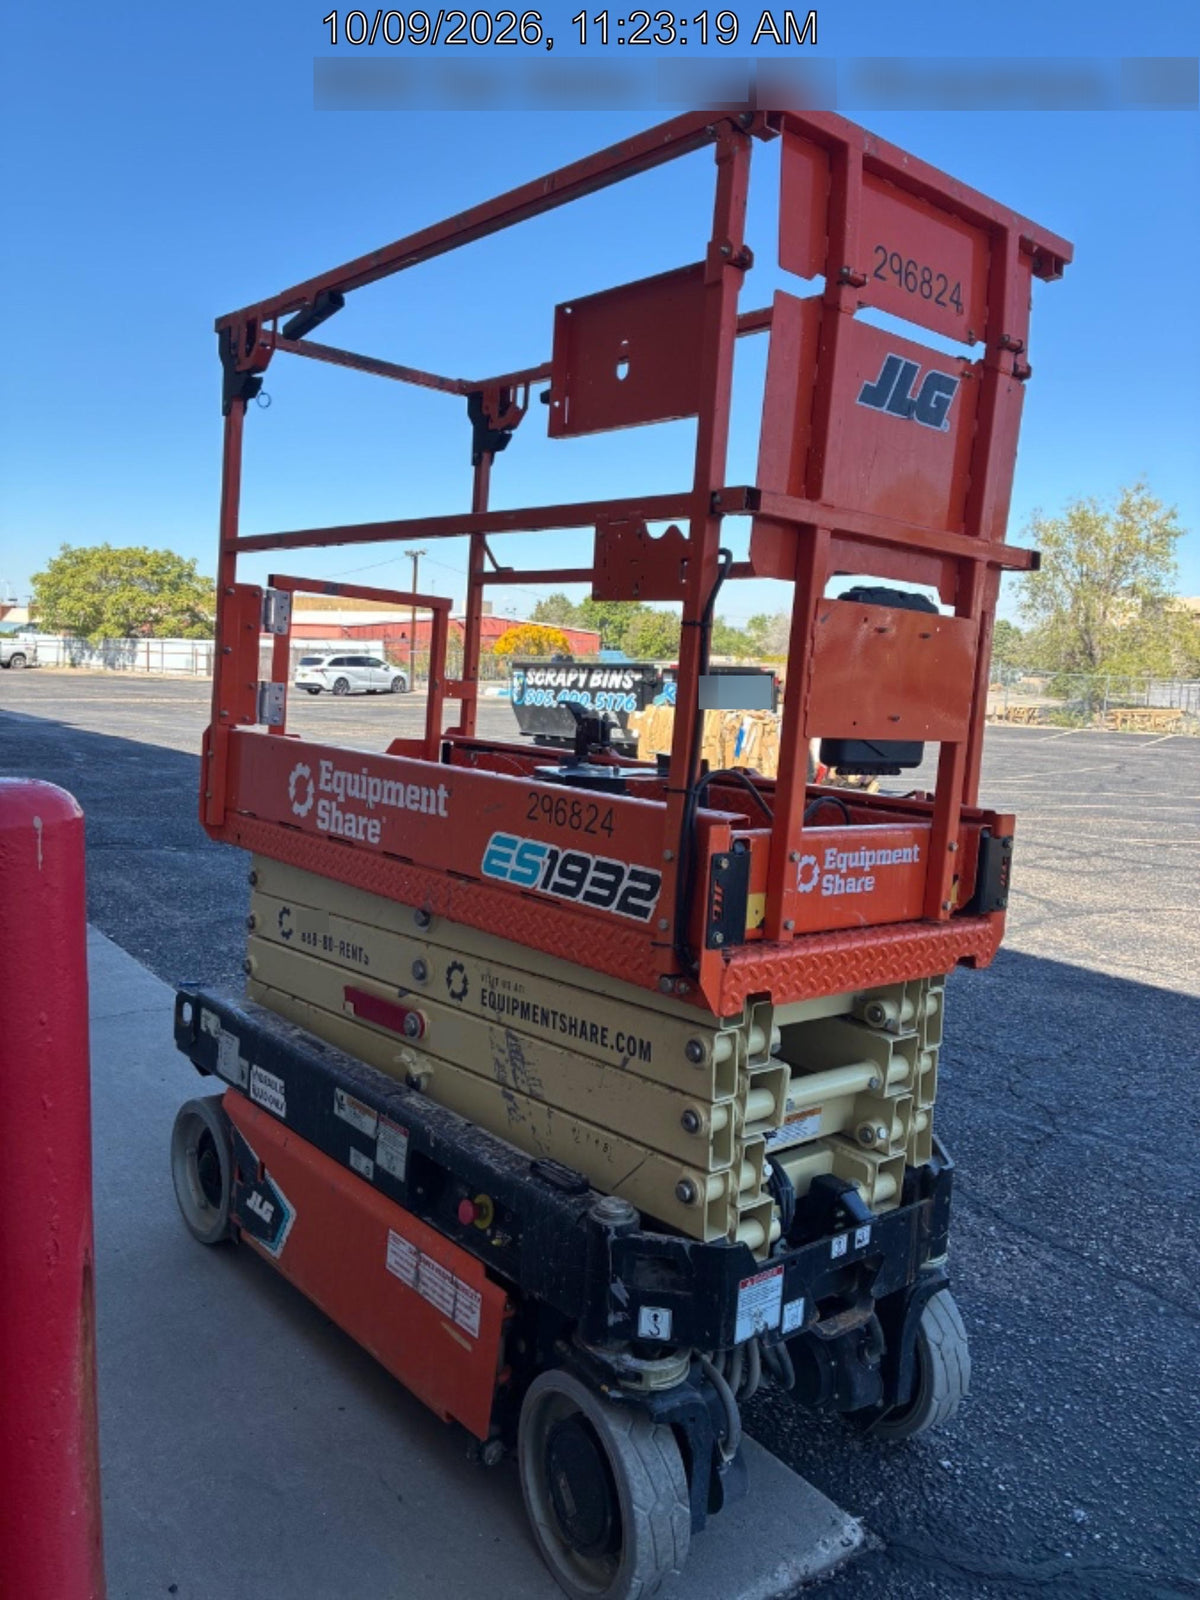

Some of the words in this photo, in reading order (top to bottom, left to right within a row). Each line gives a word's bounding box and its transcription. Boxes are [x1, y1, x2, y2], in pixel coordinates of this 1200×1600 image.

[873, 245, 963, 314] 296824
[856, 352, 961, 432] JLG
[318, 759, 450, 818] Equipment
[526, 791, 616, 838] 296824
[316, 798, 382, 844] Share
[481, 831, 663, 924] ES1932
[821, 874, 876, 896] Share
[823, 844, 920, 873] Equipment
[481, 988, 652, 1063] EQUIPMENTSHARE.COM
[246, 1190, 275, 1224] JLG
